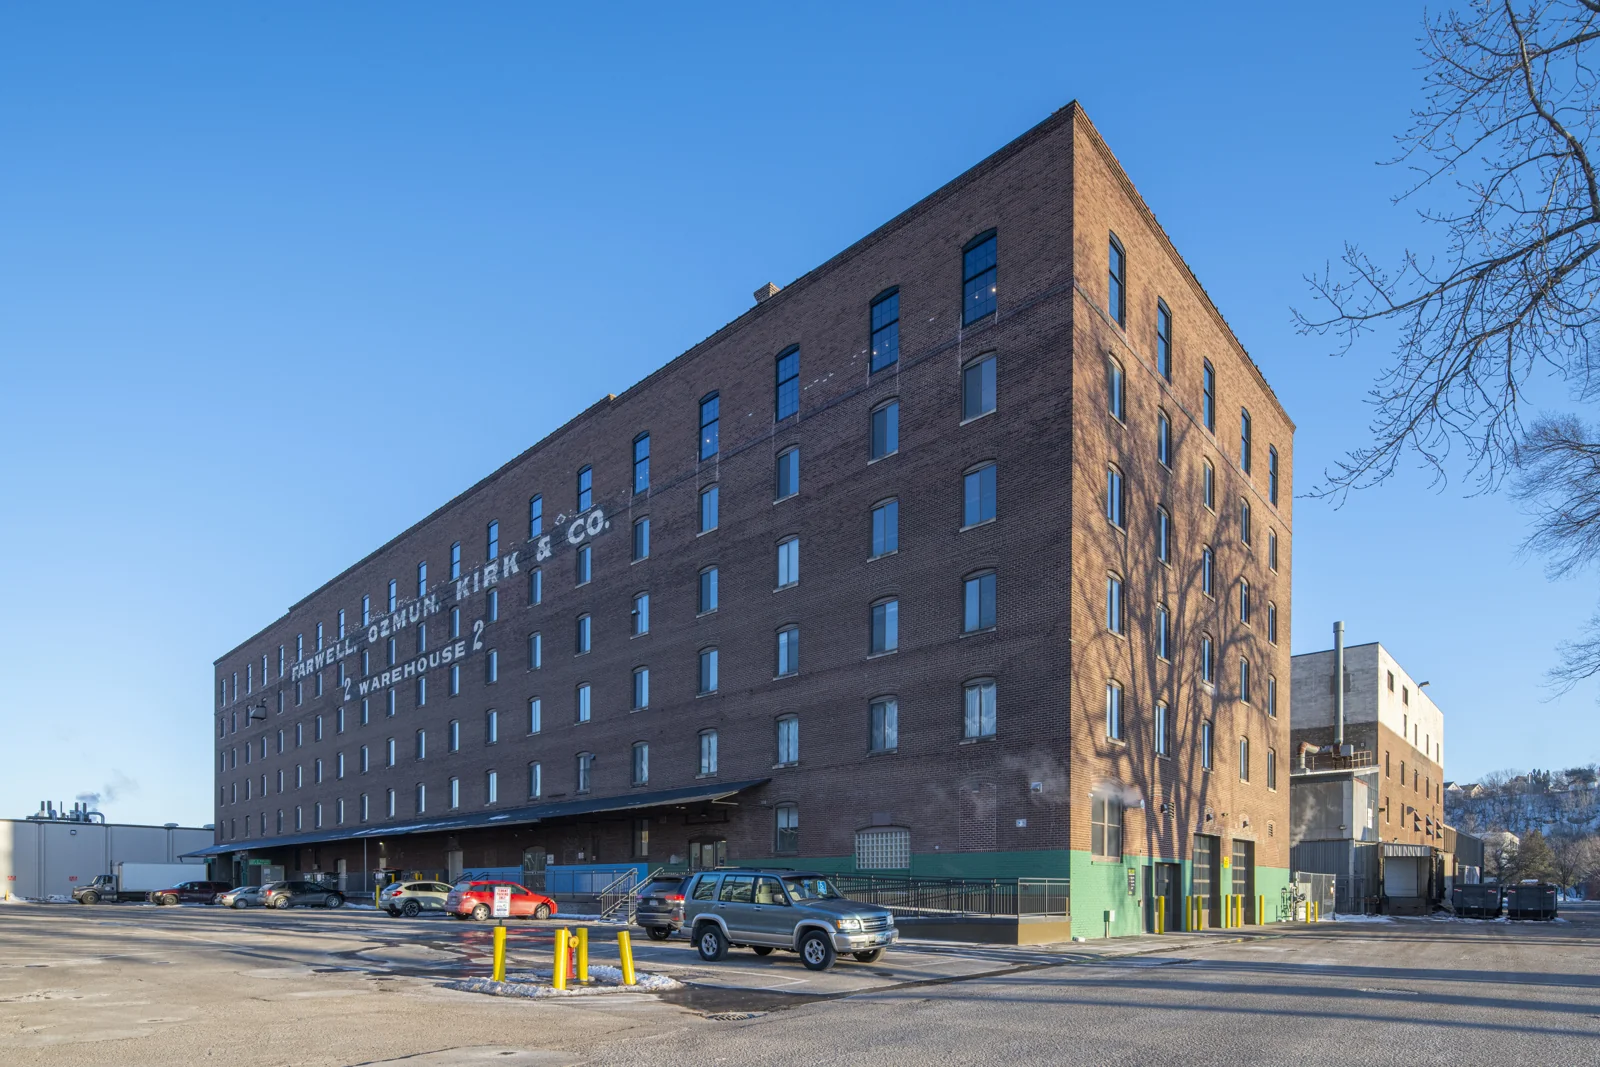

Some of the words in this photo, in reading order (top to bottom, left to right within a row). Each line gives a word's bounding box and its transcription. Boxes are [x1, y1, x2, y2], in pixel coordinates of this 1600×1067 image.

[456, 551, 520, 601] KIRK
[536, 535, 552, 562] &
[567, 509, 610, 545] CO.
[344, 677, 352, 701] 2
[359, 640, 466, 695] WAREHOUSE
[473, 620, 485, 651] 2
